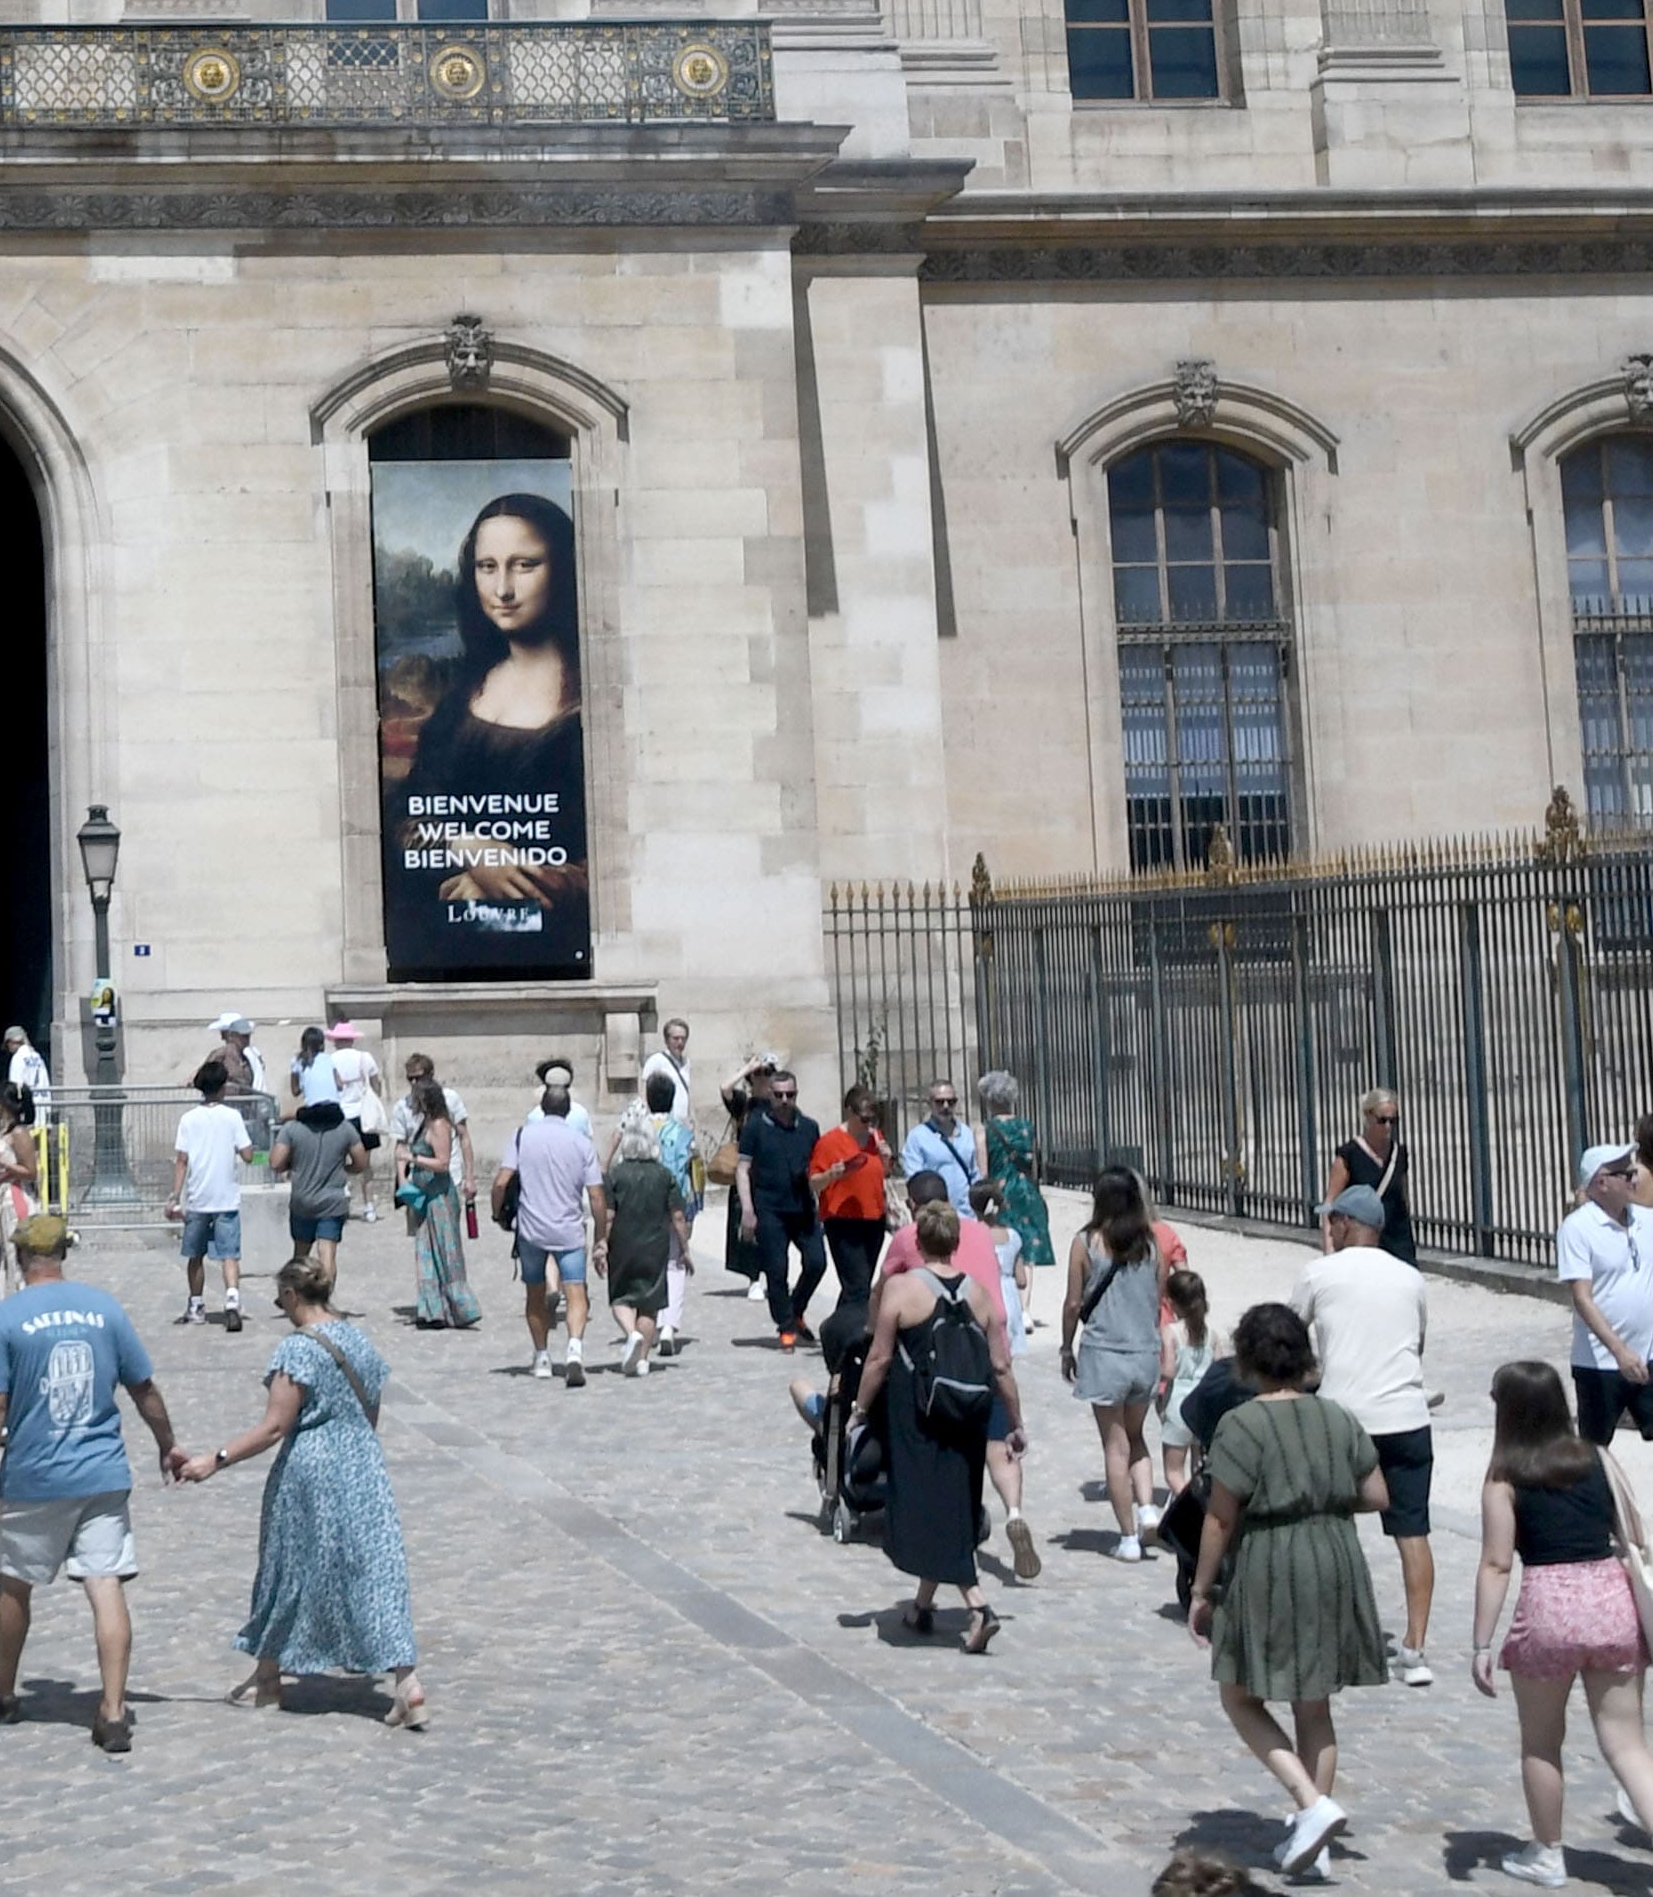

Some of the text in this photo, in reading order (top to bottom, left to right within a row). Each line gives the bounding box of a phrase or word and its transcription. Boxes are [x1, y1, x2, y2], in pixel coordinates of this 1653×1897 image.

[408, 794, 559, 815] BIENVENUE
[418, 821, 551, 841] WELCOME
[404, 847, 567, 870] BIENVENIDO
